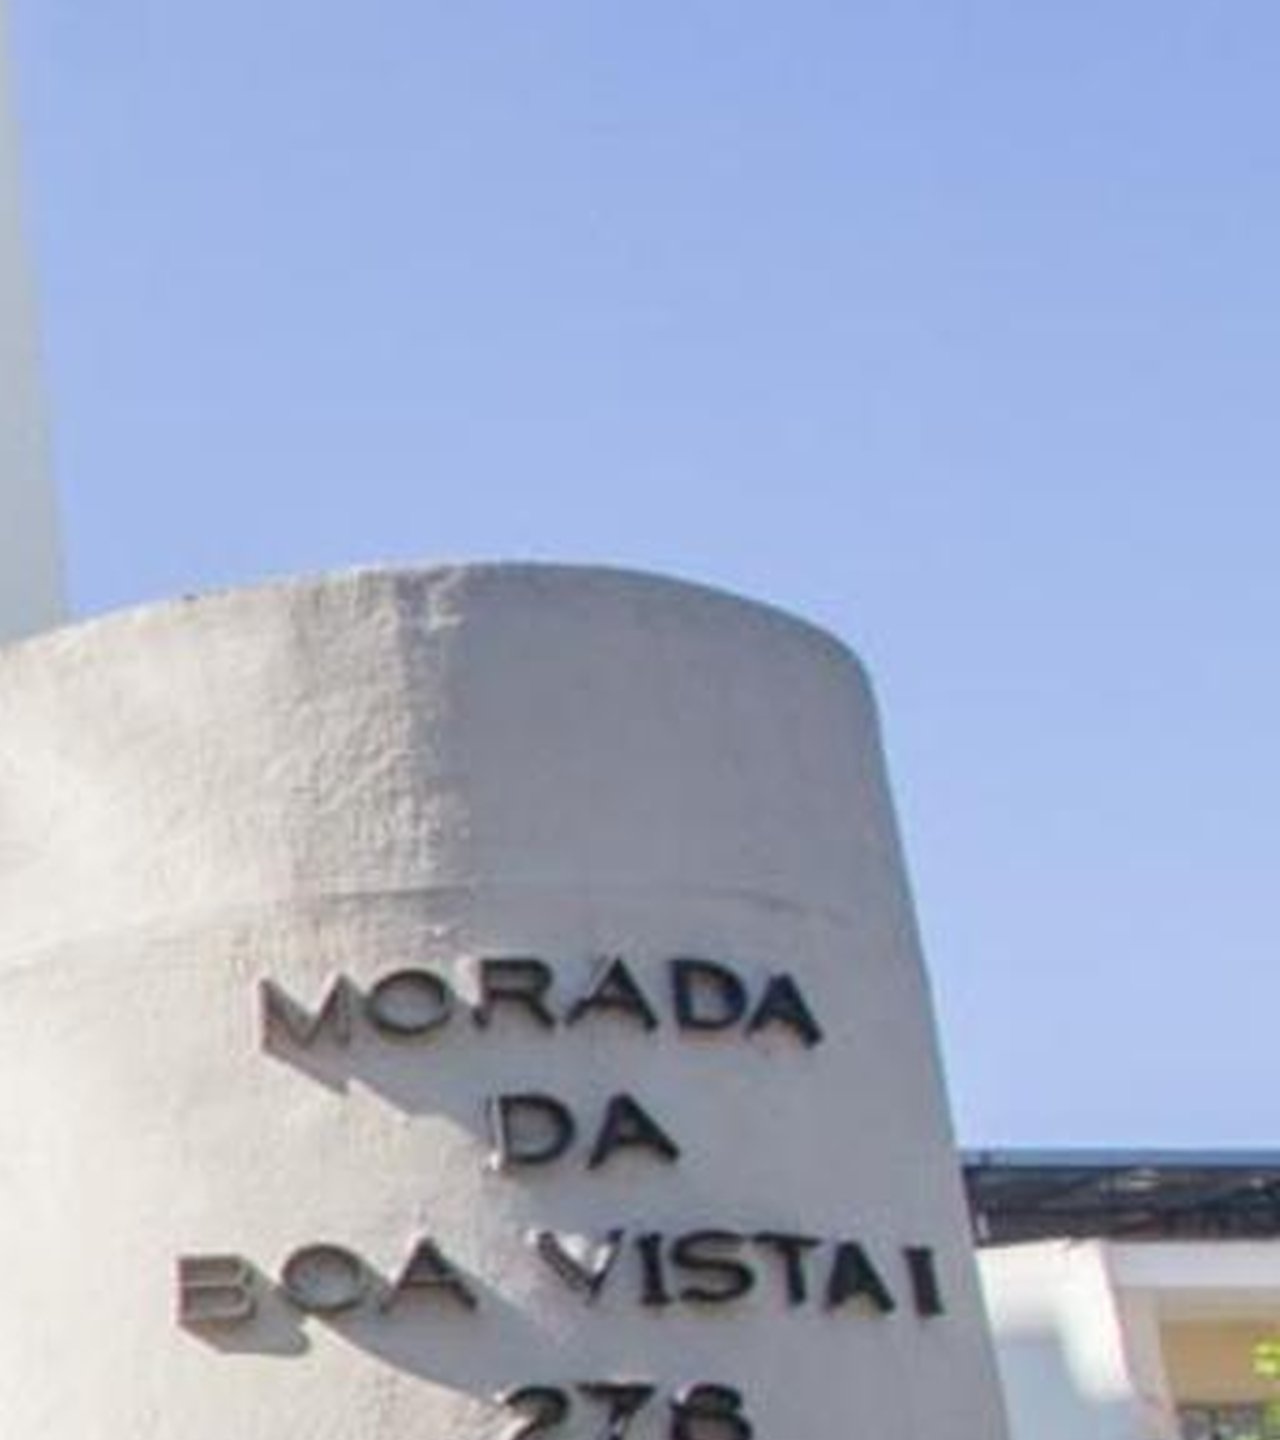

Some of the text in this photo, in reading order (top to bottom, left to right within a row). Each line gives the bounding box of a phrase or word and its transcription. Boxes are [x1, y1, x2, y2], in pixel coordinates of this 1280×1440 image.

[259, 958, 823, 1050] MORADA
[492, 1093, 680, 1169] DA
[178, 1236, 478, 1324] BOA
